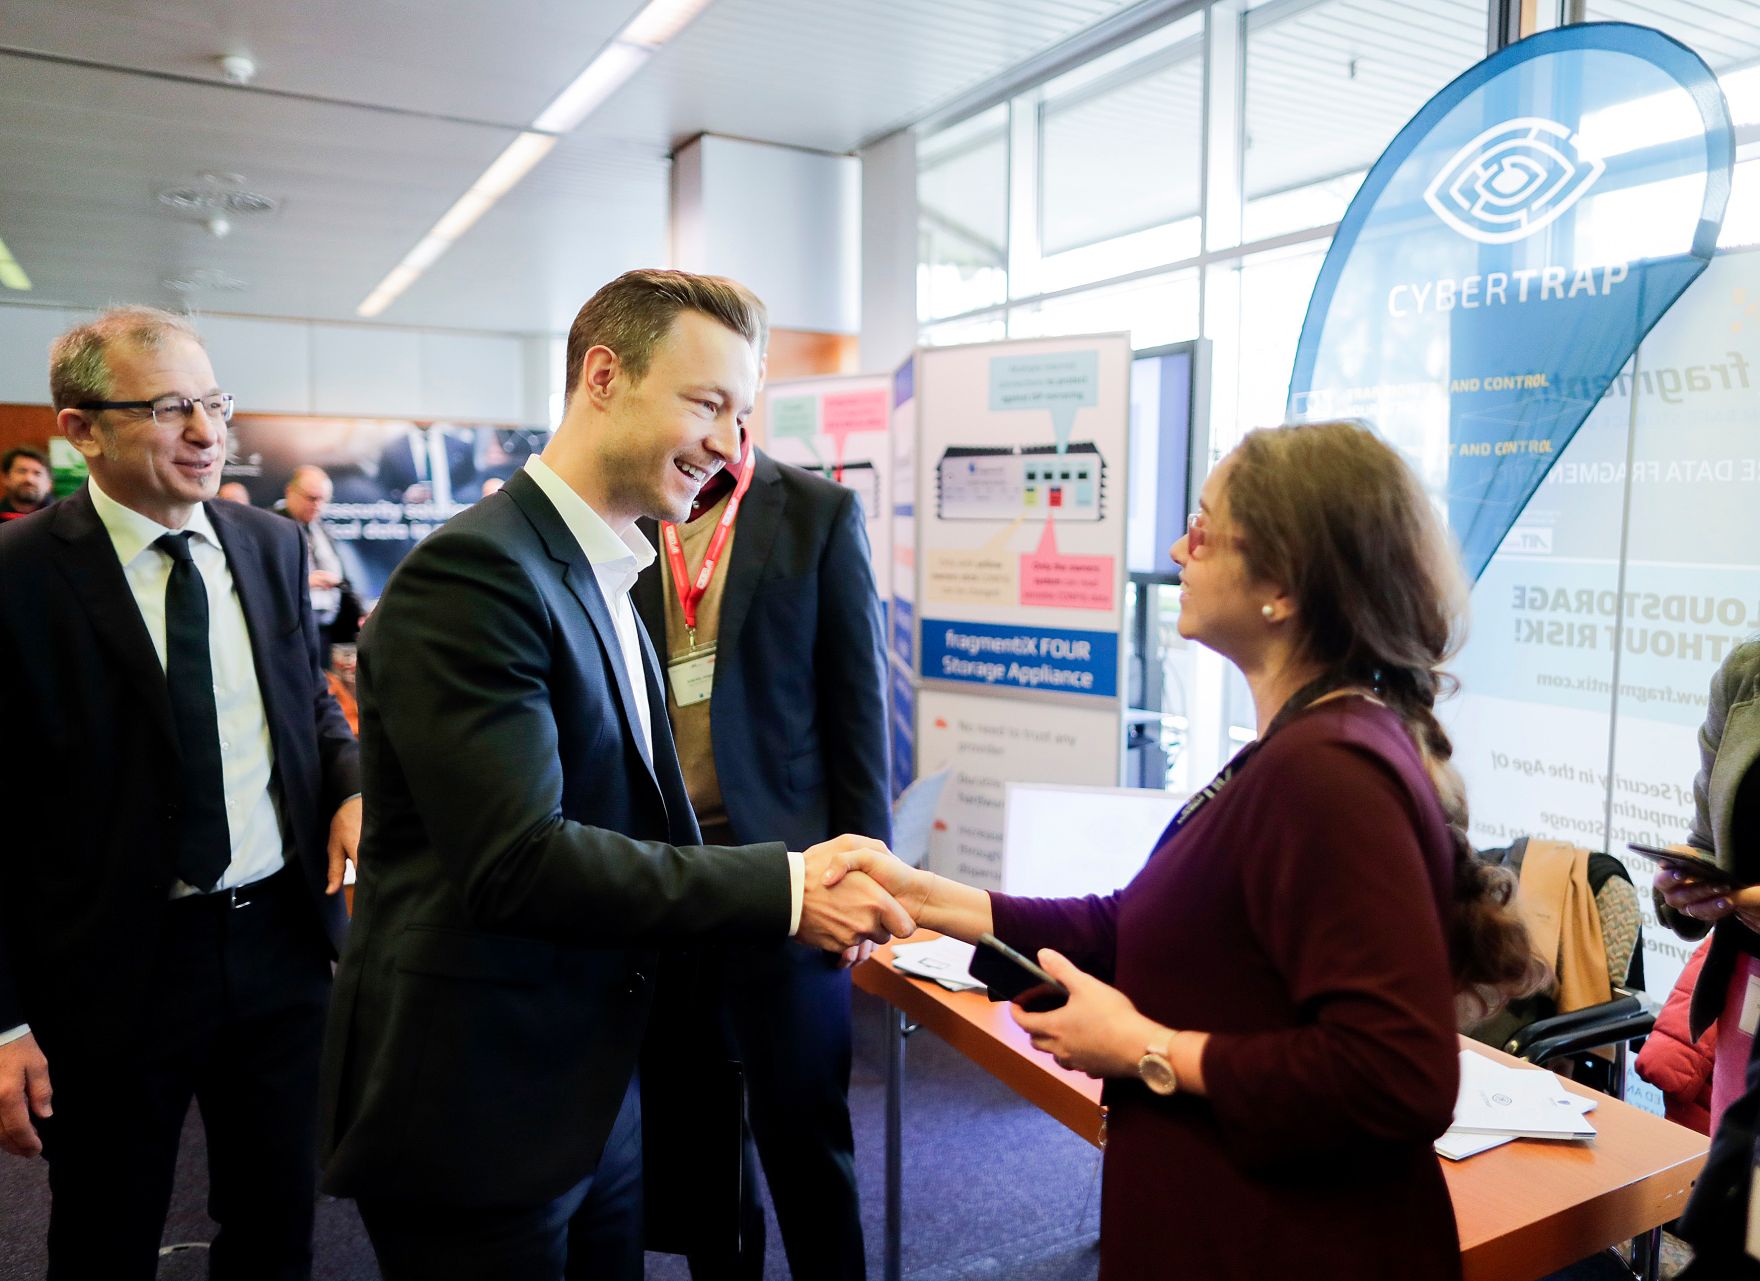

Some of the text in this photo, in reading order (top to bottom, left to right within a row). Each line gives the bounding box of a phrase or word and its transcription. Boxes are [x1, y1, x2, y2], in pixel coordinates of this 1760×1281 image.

[1388, 261, 1629, 317] CYBERTRAP
[1450, 379, 1480, 393] AND
[1484, 373, 1549, 391] CONTROL
[1459, 443, 1491, 457] AND
[1494, 439, 1554, 456] CONTROL
[1040, 638, 1091, 662] FOUR
[942, 655, 1094, 689] Storage Appliance
